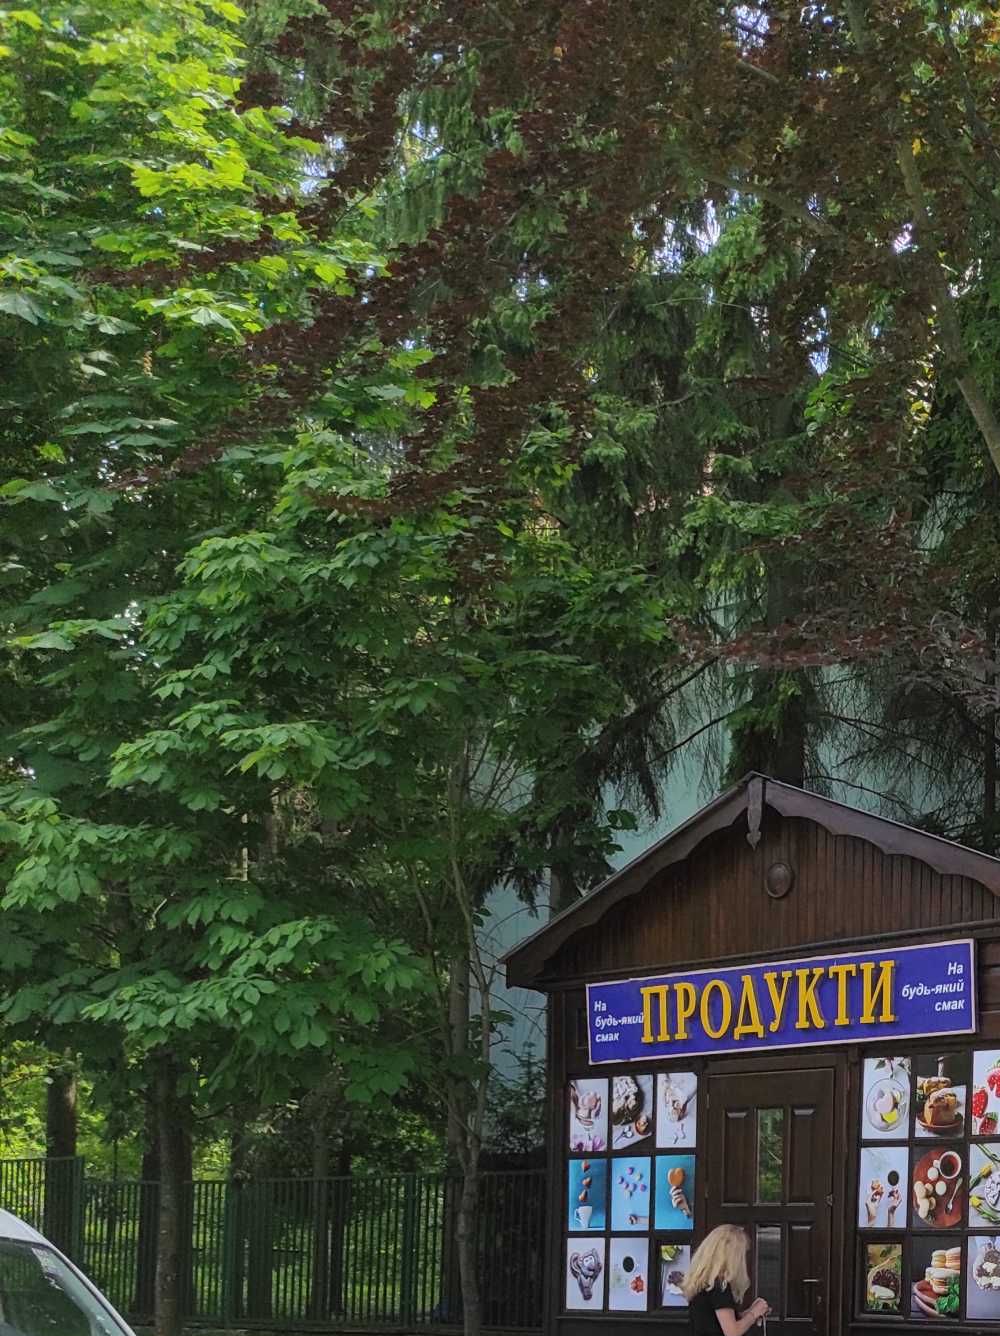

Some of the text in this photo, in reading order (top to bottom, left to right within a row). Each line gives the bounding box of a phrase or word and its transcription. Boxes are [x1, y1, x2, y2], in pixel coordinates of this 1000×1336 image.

[947, 961, 964, 976] На
[901, 979, 965, 1000] будь-який
[594, 1000, 607, 1012] На
[640, 960, 896, 1044] ПРОДУКТИ
[934, 998, 965, 1013] смак
[594, 1012, 645, 1031] будь-який
[595, 1030, 620, 1043] смак
